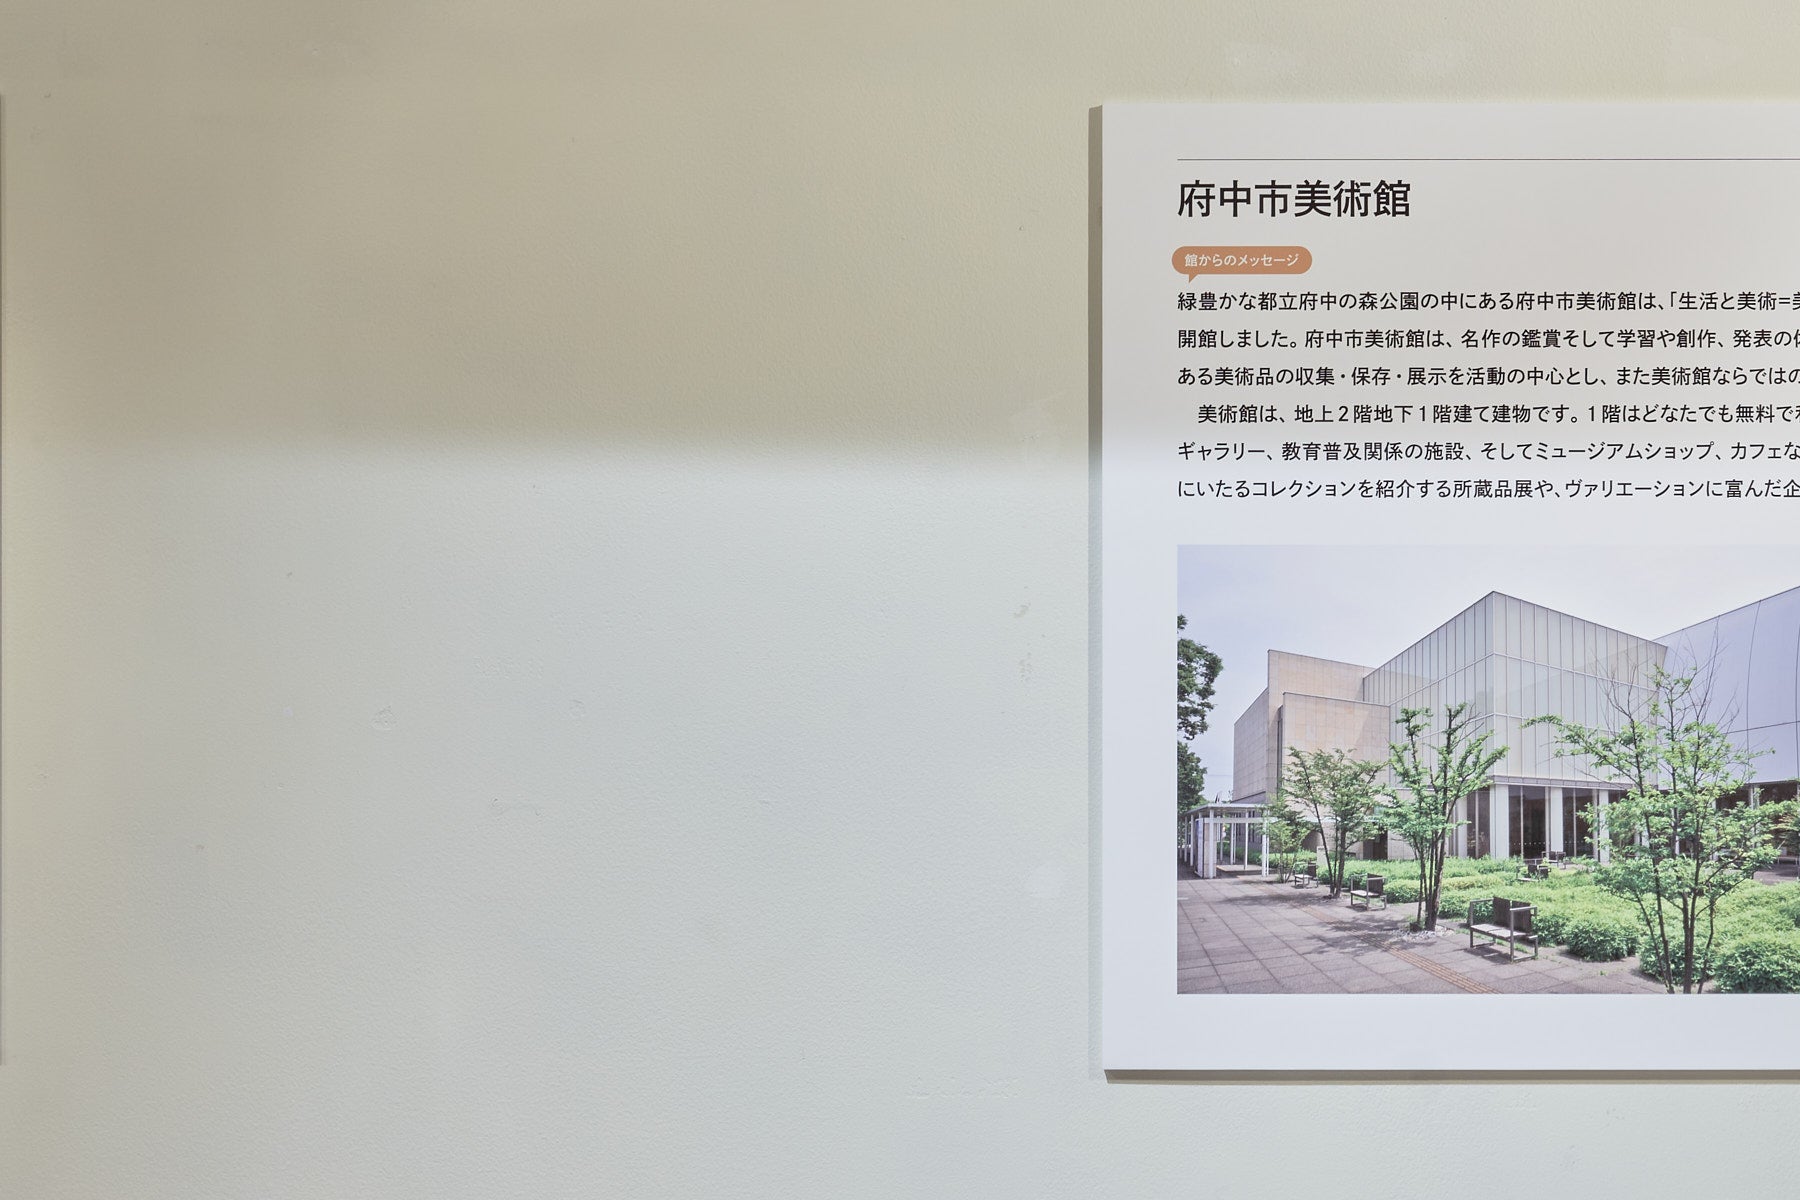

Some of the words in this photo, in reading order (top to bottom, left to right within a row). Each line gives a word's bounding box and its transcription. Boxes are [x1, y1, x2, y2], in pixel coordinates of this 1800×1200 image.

[1178, 179, 1410, 217] 府中市美術館
[1185, 254, 1299, 266] 館からのメッセージ
